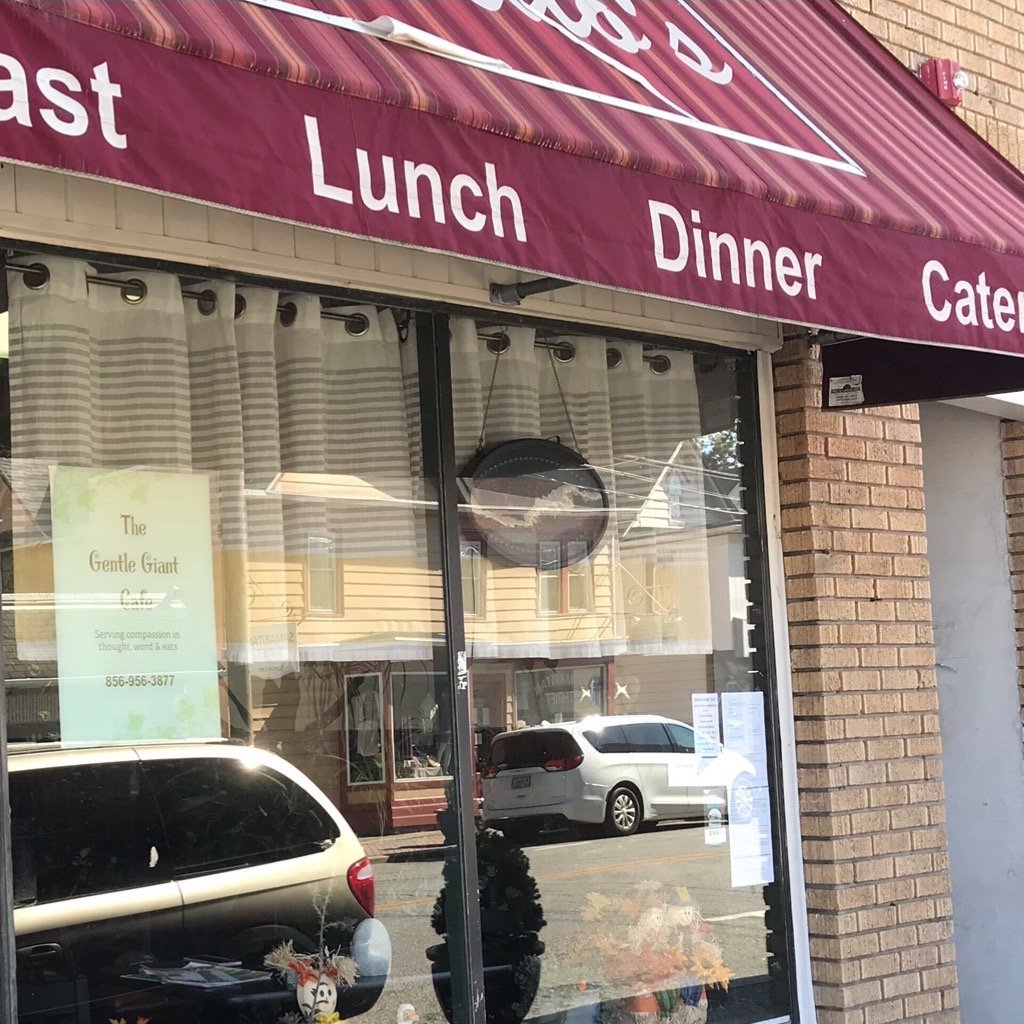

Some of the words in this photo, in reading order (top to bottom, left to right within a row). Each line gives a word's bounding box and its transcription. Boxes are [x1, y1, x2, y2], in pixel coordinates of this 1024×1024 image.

[304, 114, 527, 243] Lunch
[648, 199, 823, 300] Dinner
[120, 513, 147, 536] The
[89, 549, 136, 573] Gentle
[141, 551, 179, 574] Giant
[120, 588, 153, 611] Cafe
[94, 629, 125, 641] Serving
[126, 629, 171, 640] compassion
[172, 629, 180, 638] in
[134, 642, 155, 651] word
[155, 642, 162, 651] &
[162, 642, 178, 651] eats
[105, 675, 175, 687] 856-956-3877
